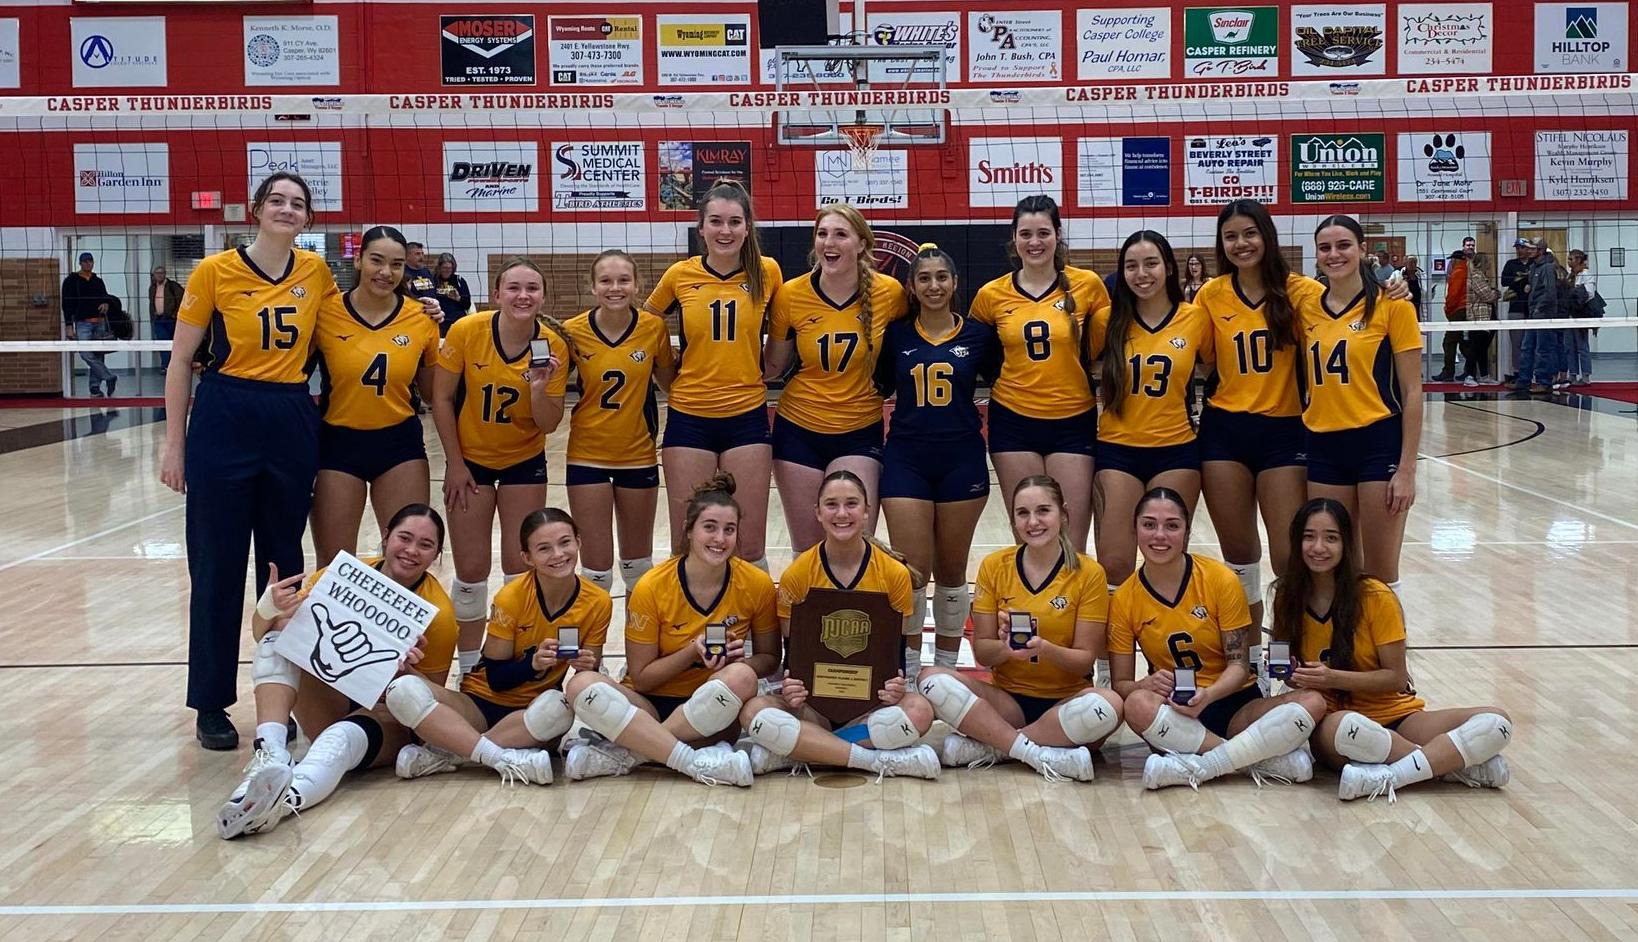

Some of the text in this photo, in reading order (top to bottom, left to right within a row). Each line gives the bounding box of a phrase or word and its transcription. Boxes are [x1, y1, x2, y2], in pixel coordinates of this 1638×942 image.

[1091, 15, 1155, 28] Supporting
[1214, 17, 1249, 28] Sinclair
[1417, 23, 1471, 32] Christmas
[459, 21, 516, 37] MOSER
[677, 29, 703, 40] Wyoming
[726, 29, 745, 40] CAT
[893, 21, 959, 42] WHITE'S
[1083, 29, 1164, 42] Casper College
[1296, 26, 1382, 35] OIL CAPITAL
[1428, 30, 1458, 38] Decor
[1332, 37, 1381, 47] SERVICE
[1552, 42, 1610, 53] HILLTOP
[571, 51, 621, 60] 307-473-7300
[661, 50, 747, 58] WWW.WYOMINGCAT.COM
[976, 52, 997, 62] John
[1011, 52, 1035, 61] Bush,
[1038, 52, 1056, 60] CPA
[1082, 50, 1166, 63] Paul Homar,
[1186, 46, 1276, 56] CASPER REFINERY
[1562, 54, 1601, 65] BANK
[1193, 61, 1213, 76] Go
[558, 72, 572, 82] CAT
[1407, 75, 1632, 93] CASPER THUNDERBIRDS
[730, 90, 950, 107] CASPER THUNDERBIRDS
[1066, 83, 1290, 101] CASPER THUNDERBIRDS
[47, 96, 272, 111] CASPER THUNDERBIRDS
[389, 95, 615, 109] CASPER THUNDERBIRDS
[1537, 132, 1627, 143] STIFEL NICOLAUS
[582, 144, 640, 156] SUMMIT
[697, 149, 747, 164] KIMRAY
[1190, 150, 1272, 158] BEVERLY STREET
[1299, 142, 1378, 163] Union
[250, 149, 299, 186] Peak
[583, 158, 641, 169] MEDICAL
[1228, 159, 1264, 167] REPAIR
[1550, 157, 1612, 167] Kevin Murphy
[450, 161, 532, 182] DRIVEN
[583, 170, 640, 181] CENTER
[978, 160, 1053, 184] Smith's
[97, 177, 162, 187] Garden Inn
[1222, 176, 1240, 184] GO
[1301, 180, 1375, 193] (888) 926-CARE
[1432, 179, 1450, 187] Jane
[1549, 175, 1615, 185] Kyle Henriksen
[466, 187, 517, 198] Marine
[1189, 185, 1274, 197] T-BIRDS!!!
[1305, 192, 1371, 200] UnionWireless.com
[1553, 188, 1609, 196] (307) 232-9450
[592, 200, 643, 208] ATHLETICS
[821, 195, 902, 205] Go T-Birds!
[709, 299, 738, 342] 11
[257, 305, 299, 350] 15
[1022, 320, 1052, 362] 8
[816, 332, 859, 374] 17
[1232, 328, 1274, 375] 10
[1310, 339, 1350, 386] 14
[361, 352, 388, 397] 4
[1129, 353, 1173, 398] 13
[600, 369, 627, 410] 2
[910, 362, 954, 408] 16
[481, 382, 520, 425] 12
[338, 562, 429, 624] CHEEEEEE
[328, 581, 411, 640] WHOOOOO
[824, 618, 869, 641] NJCAA
[1166, 631, 1203, 672] 6
